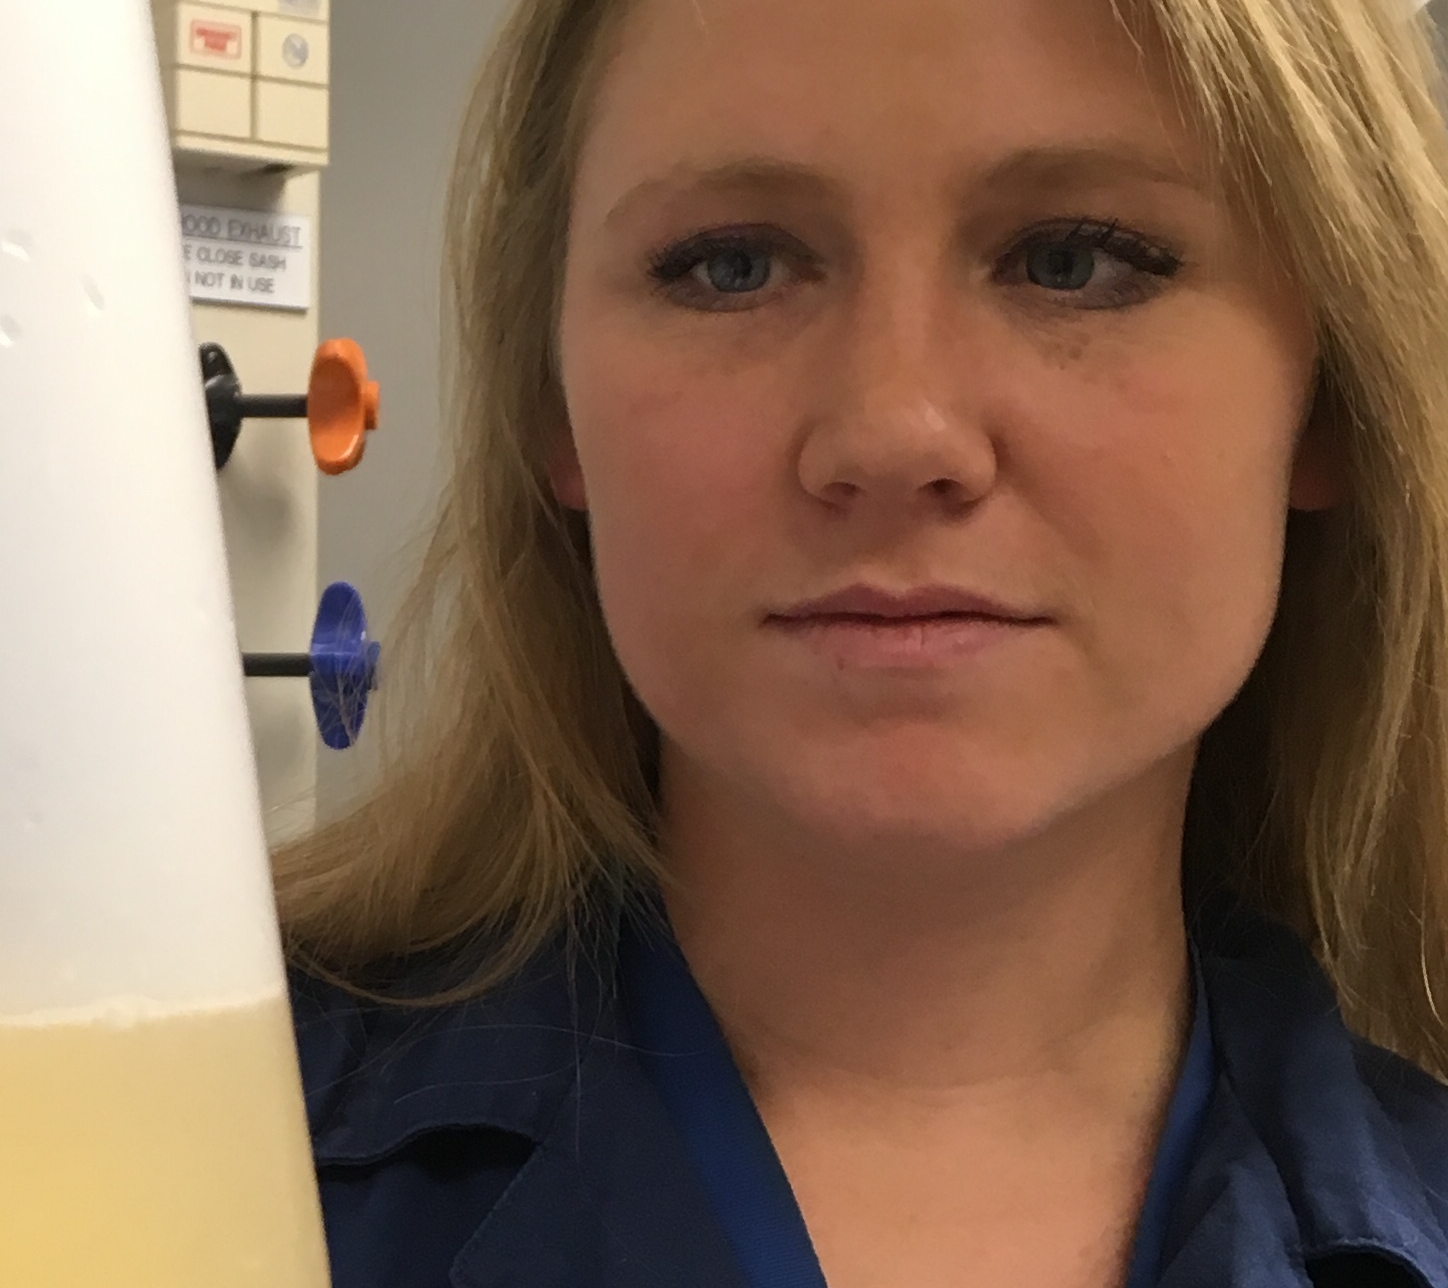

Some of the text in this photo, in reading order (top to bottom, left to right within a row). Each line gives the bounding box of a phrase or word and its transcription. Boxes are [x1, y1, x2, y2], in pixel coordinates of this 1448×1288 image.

[182, 214, 301, 246] OOD EXHAUST
[197, 246, 243, 265] CLOSE
[249, 252, 287, 271] SASH
[195, 270, 225, 288] NOT
[230, 273, 244, 290] IN
[247, 277, 275, 294] USE
